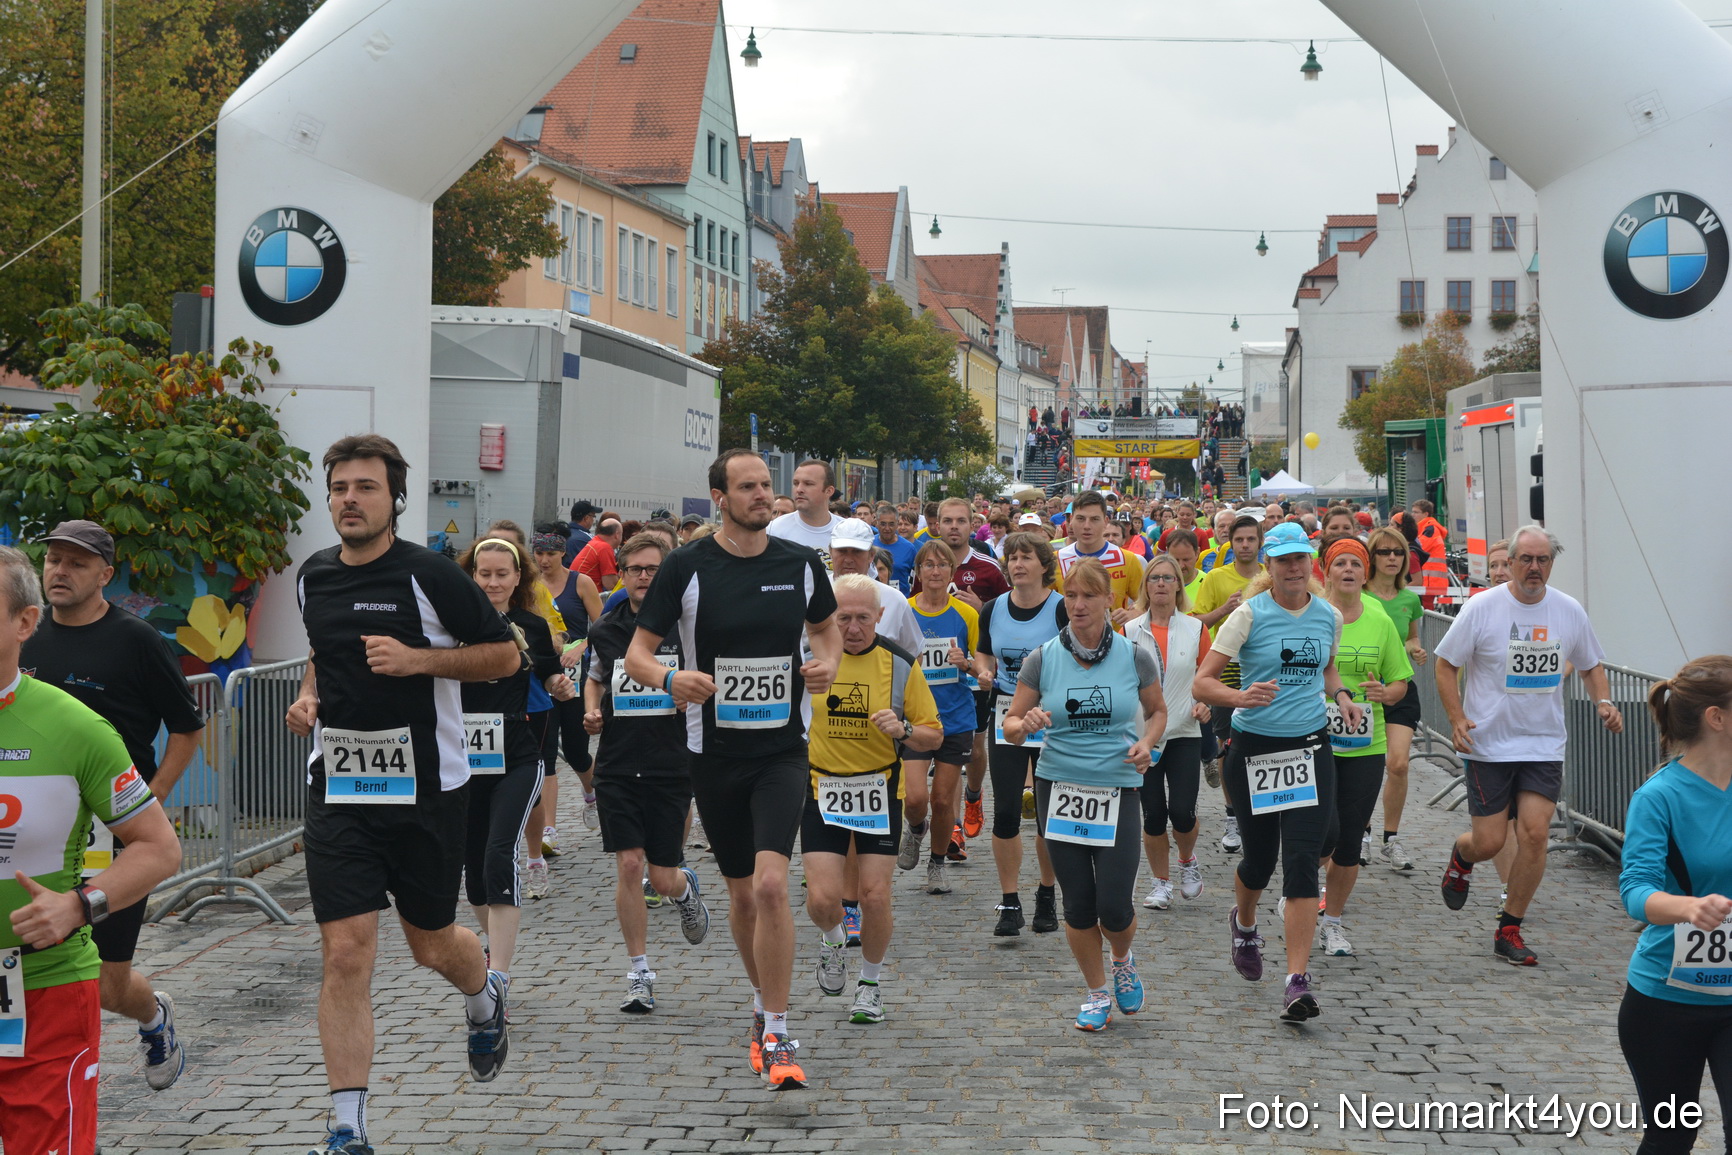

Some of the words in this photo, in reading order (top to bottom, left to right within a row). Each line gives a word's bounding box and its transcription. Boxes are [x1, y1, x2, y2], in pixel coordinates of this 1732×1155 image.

[1614, 195, 1720, 238] BMW
[246, 210, 338, 249] BMW
[685, 408, 713, 451] BOCK
[1115, 443, 1158, 454] START
[360, 603, 397, 612] PFLEIDERER
[745, 664, 780, 672] Neumarkt
[1512, 652, 1559, 674] 3329
[1280, 668, 1317, 677] HIRSCH
[724, 674, 786, 701] 2256
[629, 698, 663, 709] Rüdiger
[739, 708, 771, 719] Martin
[828, 718, 868, 728] HIRSCH
[1069, 719, 1110, 728] HIRSCH
[324, 736, 352, 744] PARTL
[354, 737, 396, 745] Neumarkt
[4, 749, 31, 760] RACER
[333, 746, 407, 773] 2144
[1271, 756, 1302, 764] Neumarkt
[1255, 763, 1309, 791] 2703
[354, 781, 388, 792] Bernd
[1053, 784, 1075, 792] PARTL
[1076, 788, 1109, 796] Neumarkt
[826, 789, 882, 813] 2816
[1273, 793, 1295, 803] Petra
[1056, 793, 1111, 822] 2301
[834, 816, 875, 828] Wolfgang
[1074, 825, 1089, 836] Pia
